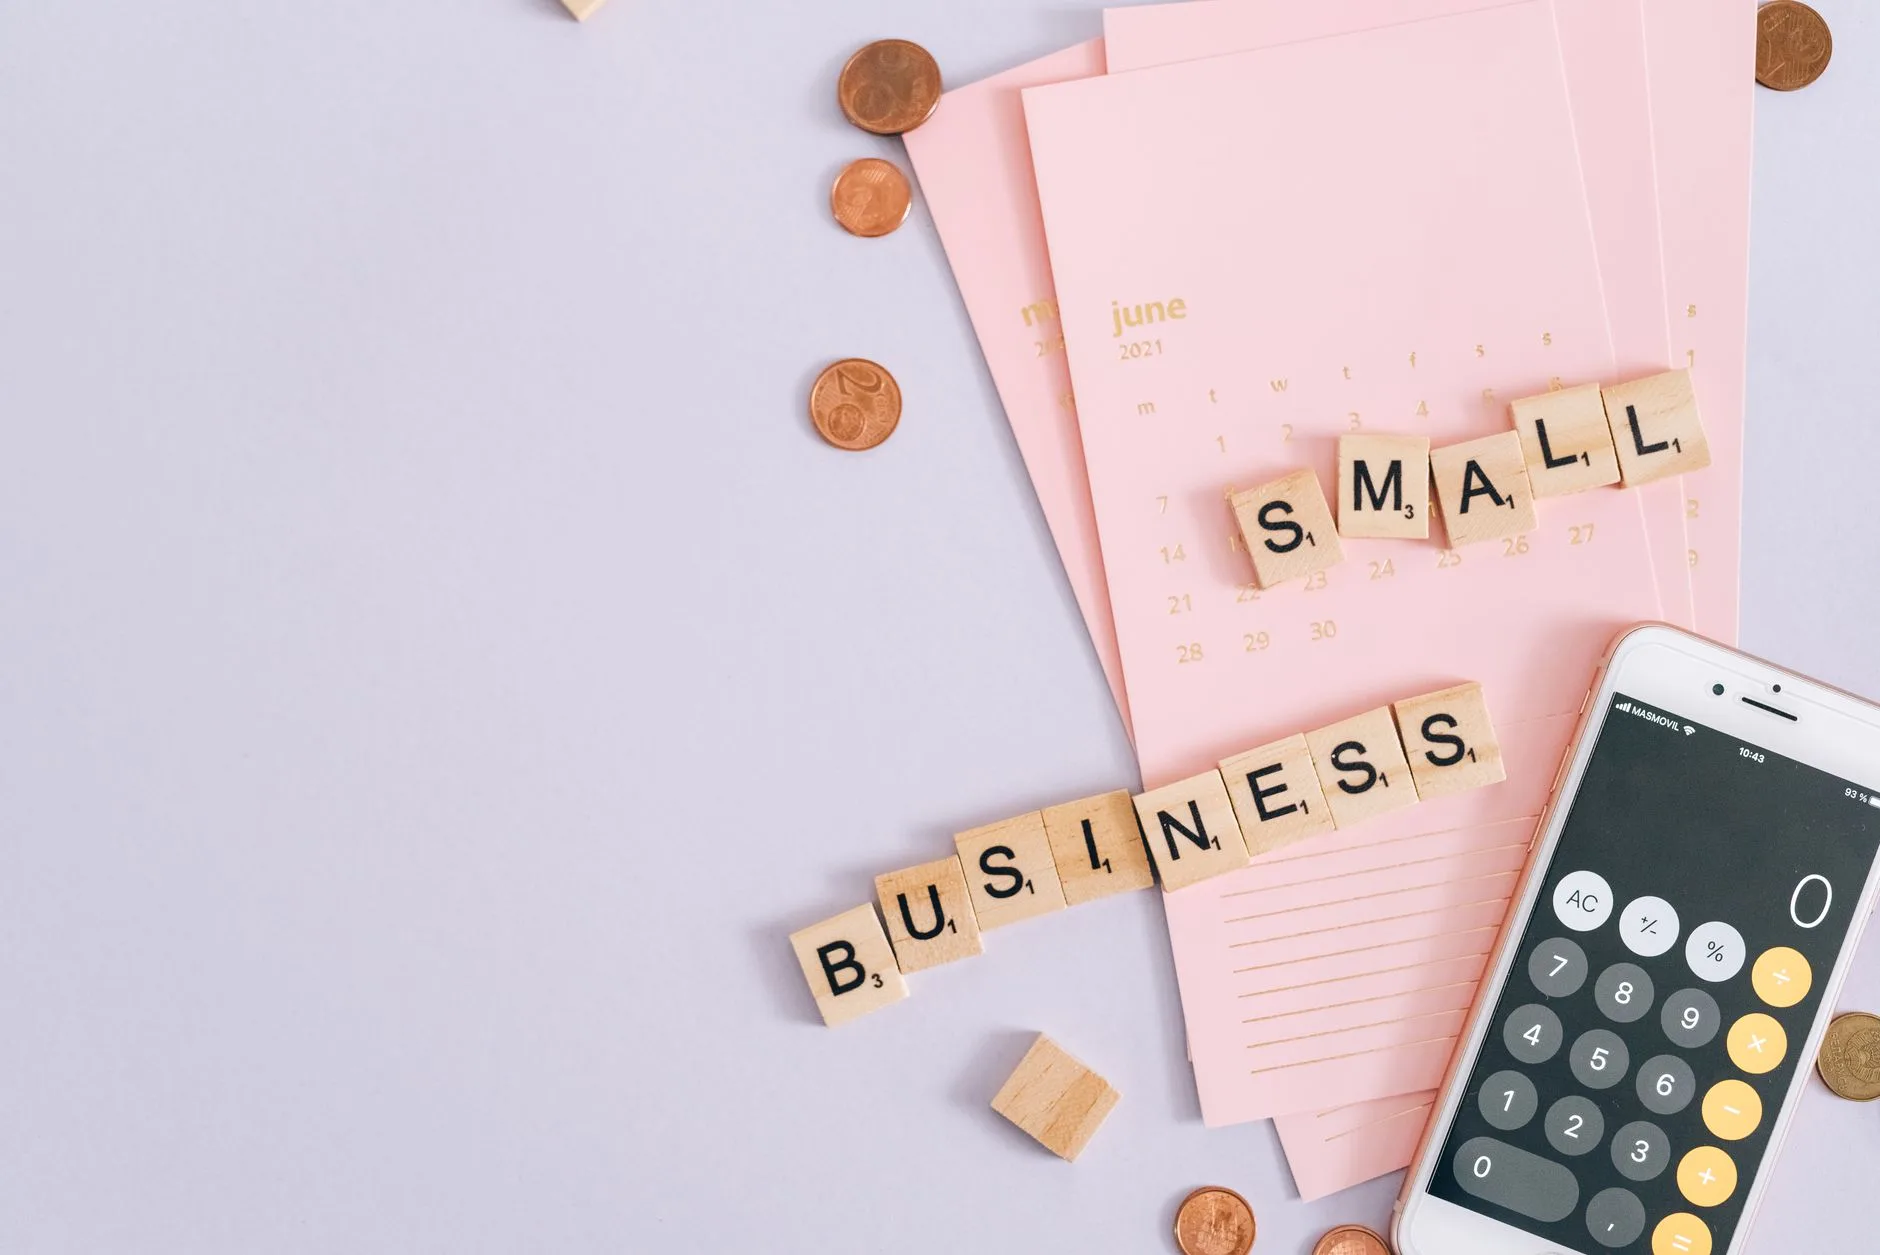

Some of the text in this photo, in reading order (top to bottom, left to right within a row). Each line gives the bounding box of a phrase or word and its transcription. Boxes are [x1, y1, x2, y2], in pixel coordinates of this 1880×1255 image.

[1111, 297, 1187, 337] june
[1686, 304, 1696, 319] s
[1119, 339, 1163, 360] 2021
[1137, 332, 1552, 415] m t w t f s s
[1216, 435, 1226, 453] 1
[1281, 424, 1294, 442] 2
[1348, 412, 1362, 431] 3
[1416, 400, 1429, 418] 4
[1156, 495, 1168, 514] 7
[1160, 543, 1186, 564] 14
[1168, 593, 1193, 615] 21
[1304, 570, 1328, 591] 23
[1369, 558, 1395, 580] 24
[1437, 550, 1462, 569] 25
[1502, 535, 1529, 557] 26
[1568, 523, 1595, 546] 27
[1176, 620, 1337, 664] 28 29 30
[1632, 705, 1680, 732] MASMOVIL
[1739, 746, 1765, 764] 10:43
[1844, 787, 1858, 799] 93
[1566, 890, 1599, 913] AC
[1790, 873, 1833, 929] 0
[1549, 954, 1569, 977] 7
[1614, 981, 1634, 1005] 8
[1680, 1007, 1700, 1030] 9
[1522, 1024, 1542, 1046] 4
[1590, 1047, 1609, 1071] 5
[1656, 1073, 1675, 1096] 6
[1503, 1090, 1515, 1112] 1
[1563, 1114, 1584, 1139] 2
[1630, 1139, 1650, 1163] 3
[1473, 1155, 1492, 1178] 0
